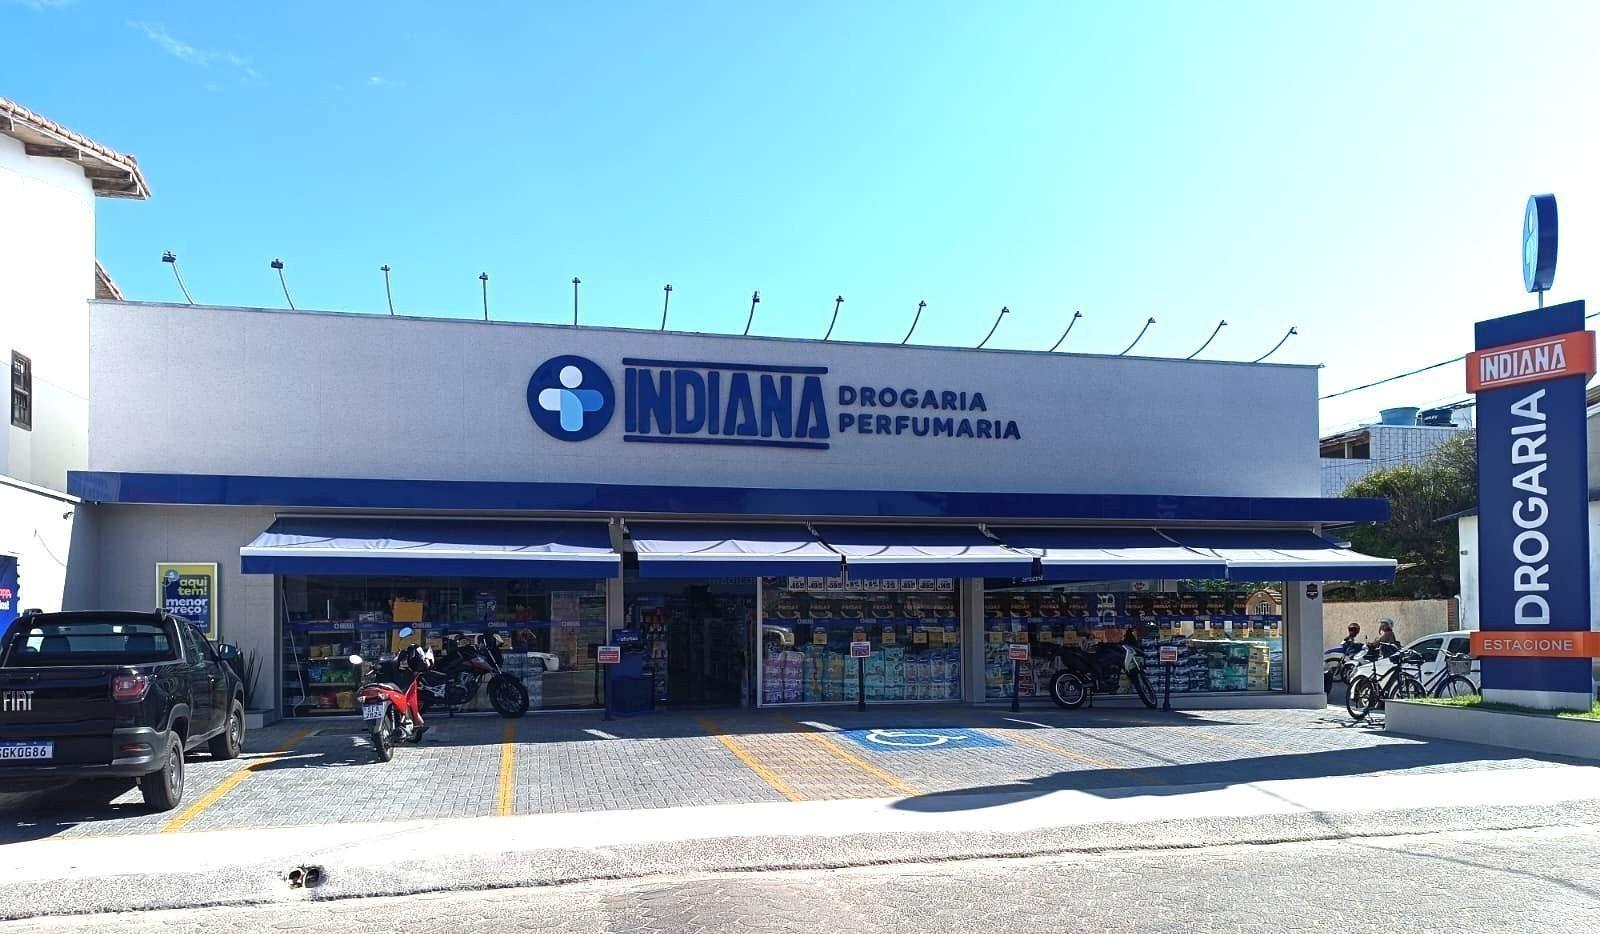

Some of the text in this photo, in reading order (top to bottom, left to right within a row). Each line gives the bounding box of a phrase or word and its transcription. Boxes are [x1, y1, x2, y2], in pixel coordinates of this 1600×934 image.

[1480, 343, 1567, 382] INDIANA
[624, 367, 830, 438] INDIANA
[838, 385, 987, 412] DROGARIA
[839, 413, 1021, 440] PERFUMARIA
[1510, 388, 1550, 625] DROGARIA
[178, 586, 208, 596] tem!
[179, 576, 208, 588] aqui
[166, 598, 208, 606] menor
[1483, 639, 1573, 651] ESTACIONE
[3, 690, 34, 711] FIAT
